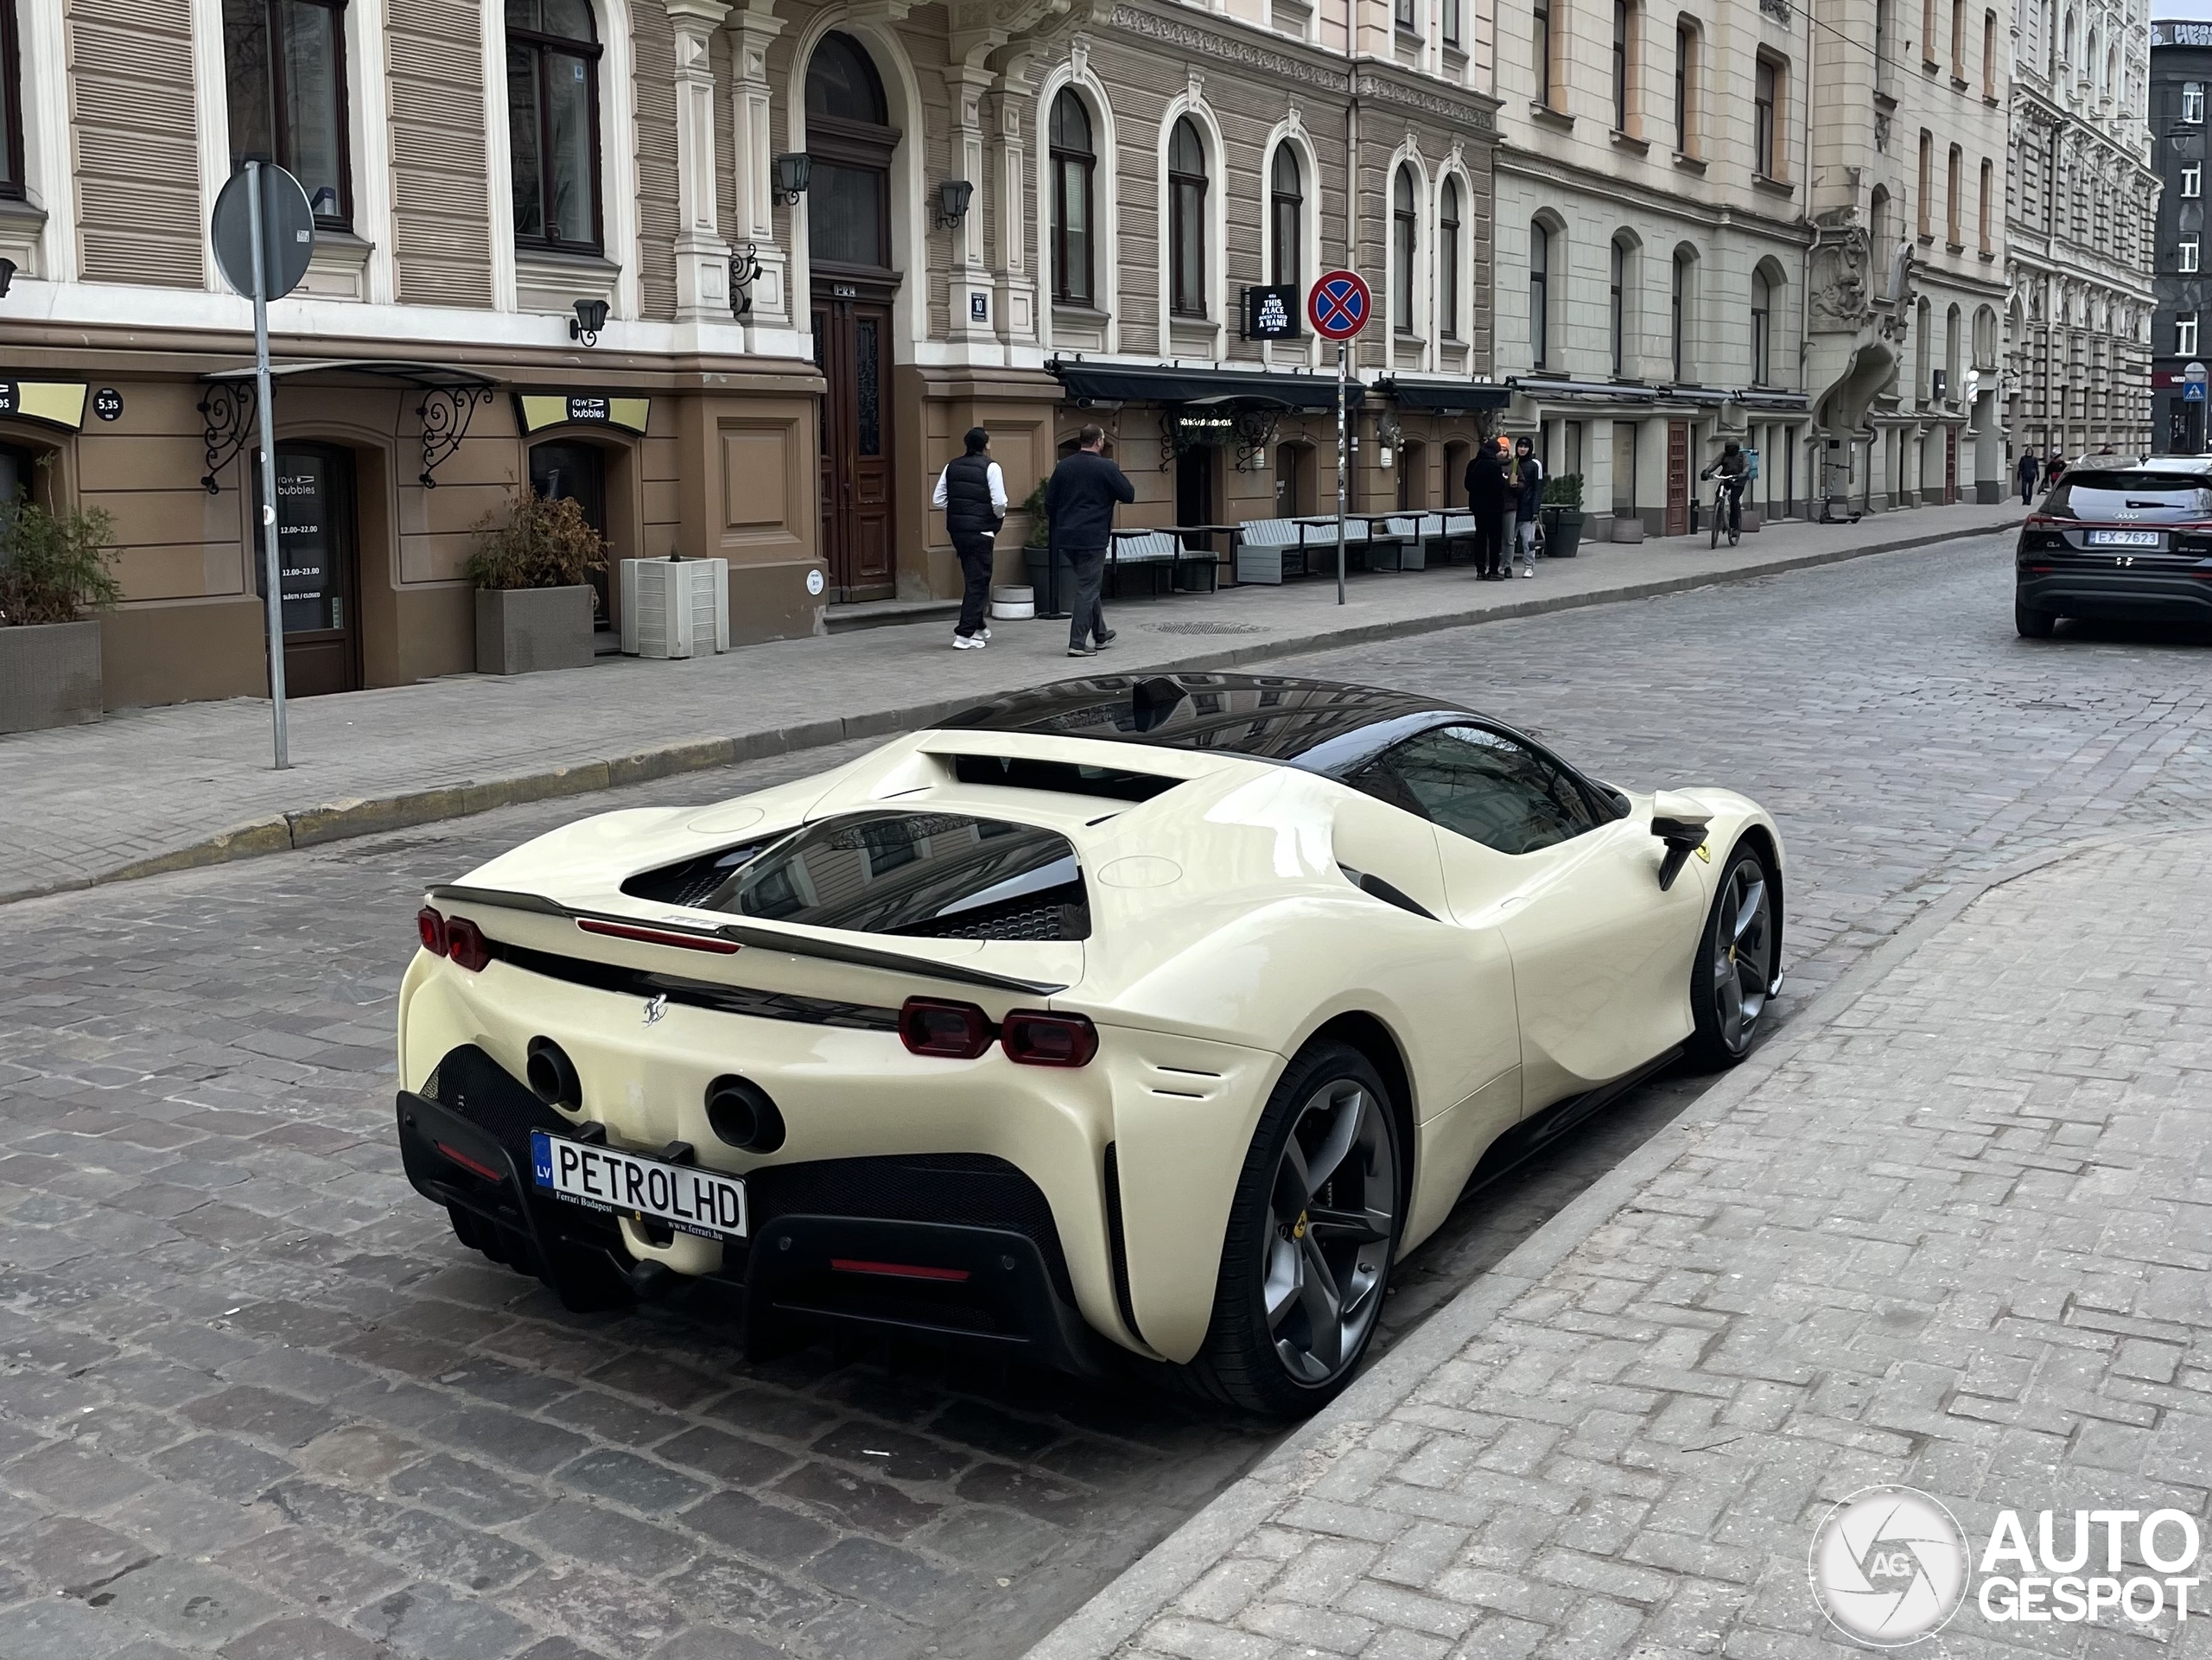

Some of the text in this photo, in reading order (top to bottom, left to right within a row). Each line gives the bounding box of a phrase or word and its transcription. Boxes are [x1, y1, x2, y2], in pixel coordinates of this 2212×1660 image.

[976, 299, 982, 312] 10
[99, 398, 118, 410] 5,35
[572, 408, 605, 417] bubbles
[277, 486, 315, 495] bubbles
[2098, 531, 2157, 544] EX-7623
[537, 1164, 550, 1179] LV
[559, 1144, 741, 1229] PETROLHD
[556, 1191, 613, 1213] Ferrari Budapest
[667, 1219, 723, 1241] www.ferrari.hu
